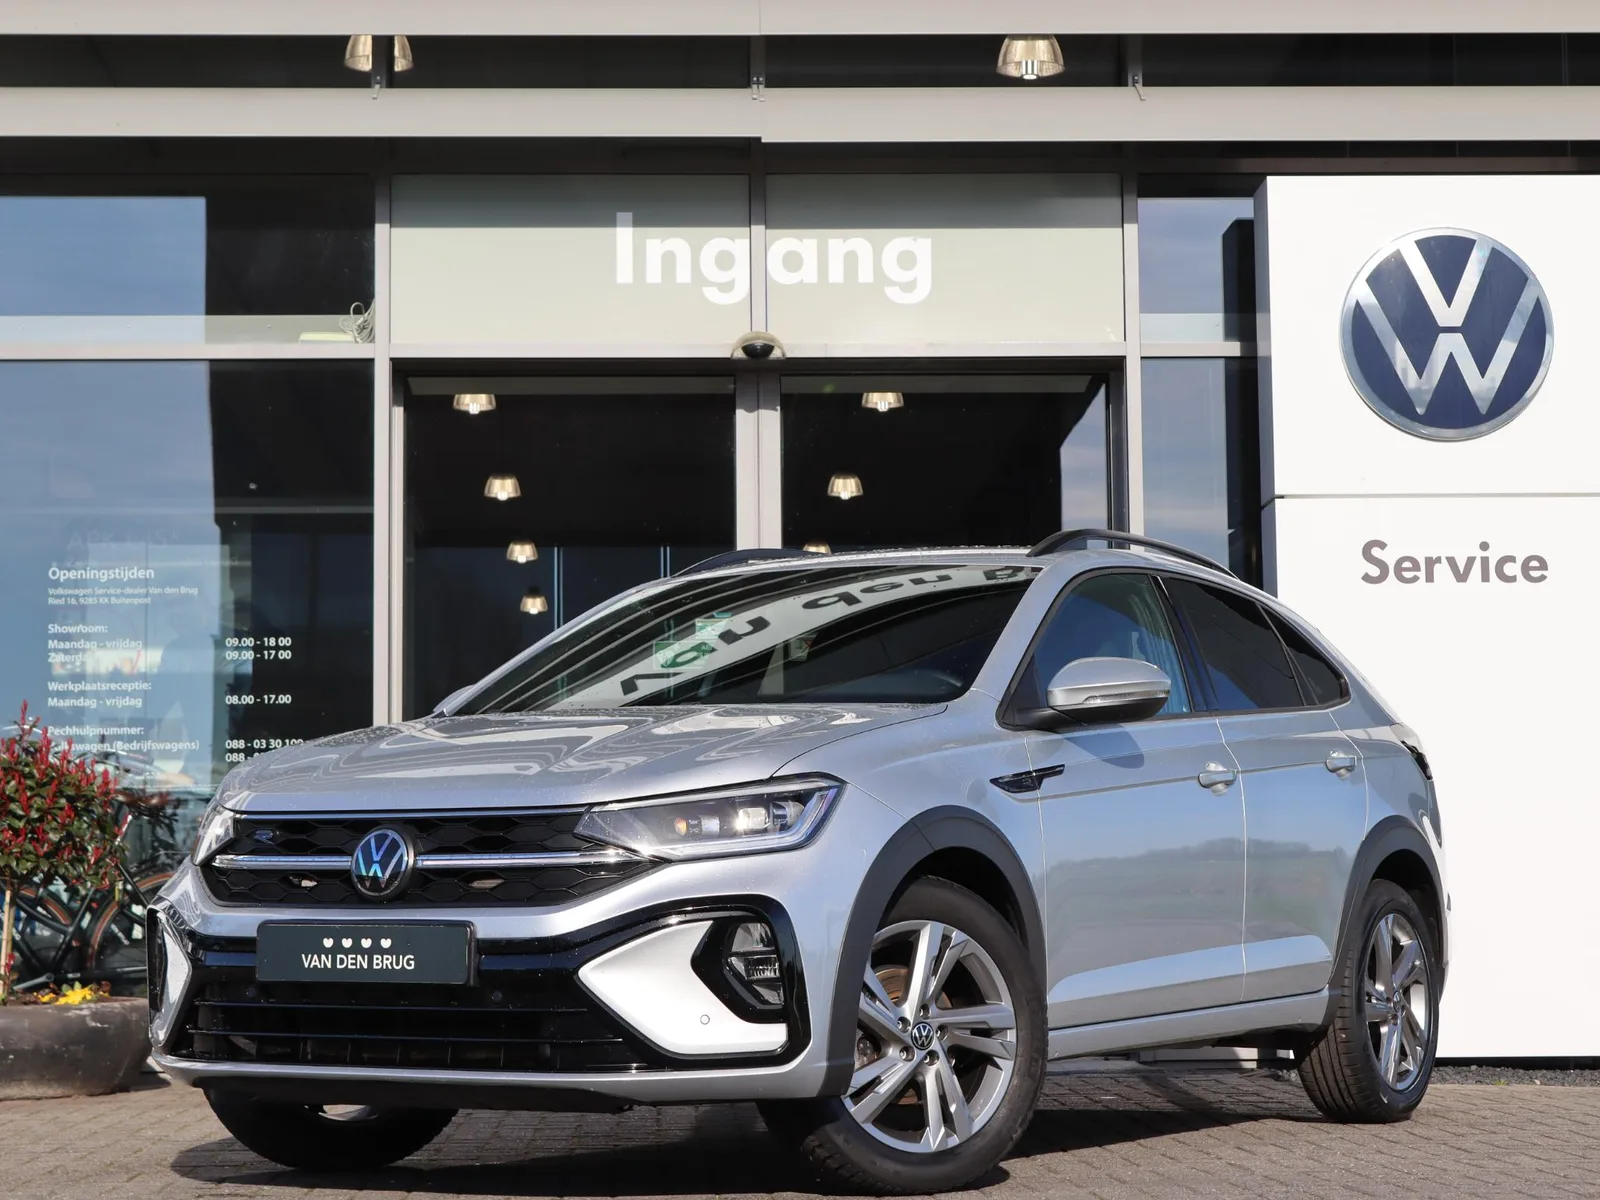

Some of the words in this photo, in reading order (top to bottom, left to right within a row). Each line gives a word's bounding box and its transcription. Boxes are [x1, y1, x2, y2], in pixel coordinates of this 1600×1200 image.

[616, 212, 932, 305] Ingang
[1361, 539, 1549, 584] Service
[48, 567, 155, 582] Openingstijden
[47, 587, 93, 597] Volkswagen
[149, 586, 163, 595] Van
[164, 586, 179, 595] den
[180, 586, 199, 597] Brug
[47, 597, 65, 605] Ried
[110, 597, 151, 606] Buitenpost
[48, 624, 108, 634] Showroom:
[48, 639, 97, 650] Maandag
[106, 639, 143, 650] vrijdag
[225, 637, 255, 647] 09.00
[48, 652, 92, 664] Zaterda
[225, 650, 255, 660] 09.00
[48, 682, 152, 693] Werkplaatsreceptie:
[48, 697, 97, 708] Maandag
[106, 697, 143, 708] vrijdag
[225, 695, 255, 705] 08.00
[263, 695, 292, 704] 17.00
[48, 726, 144, 737] Pechhulpnummer:
[48, 740, 110, 752] olswagen
[113, 740, 200, 751] (Bedrijfswagens)
[225, 739, 245, 749] 088
[253, 739, 267, 748] 03
[269, 739, 282, 748] 30
[225, 752, 245, 762] 088
[302, 954, 332, 969] VAN
[336, 954, 368, 969] DEN
[373, 954, 415, 970] BRUG
